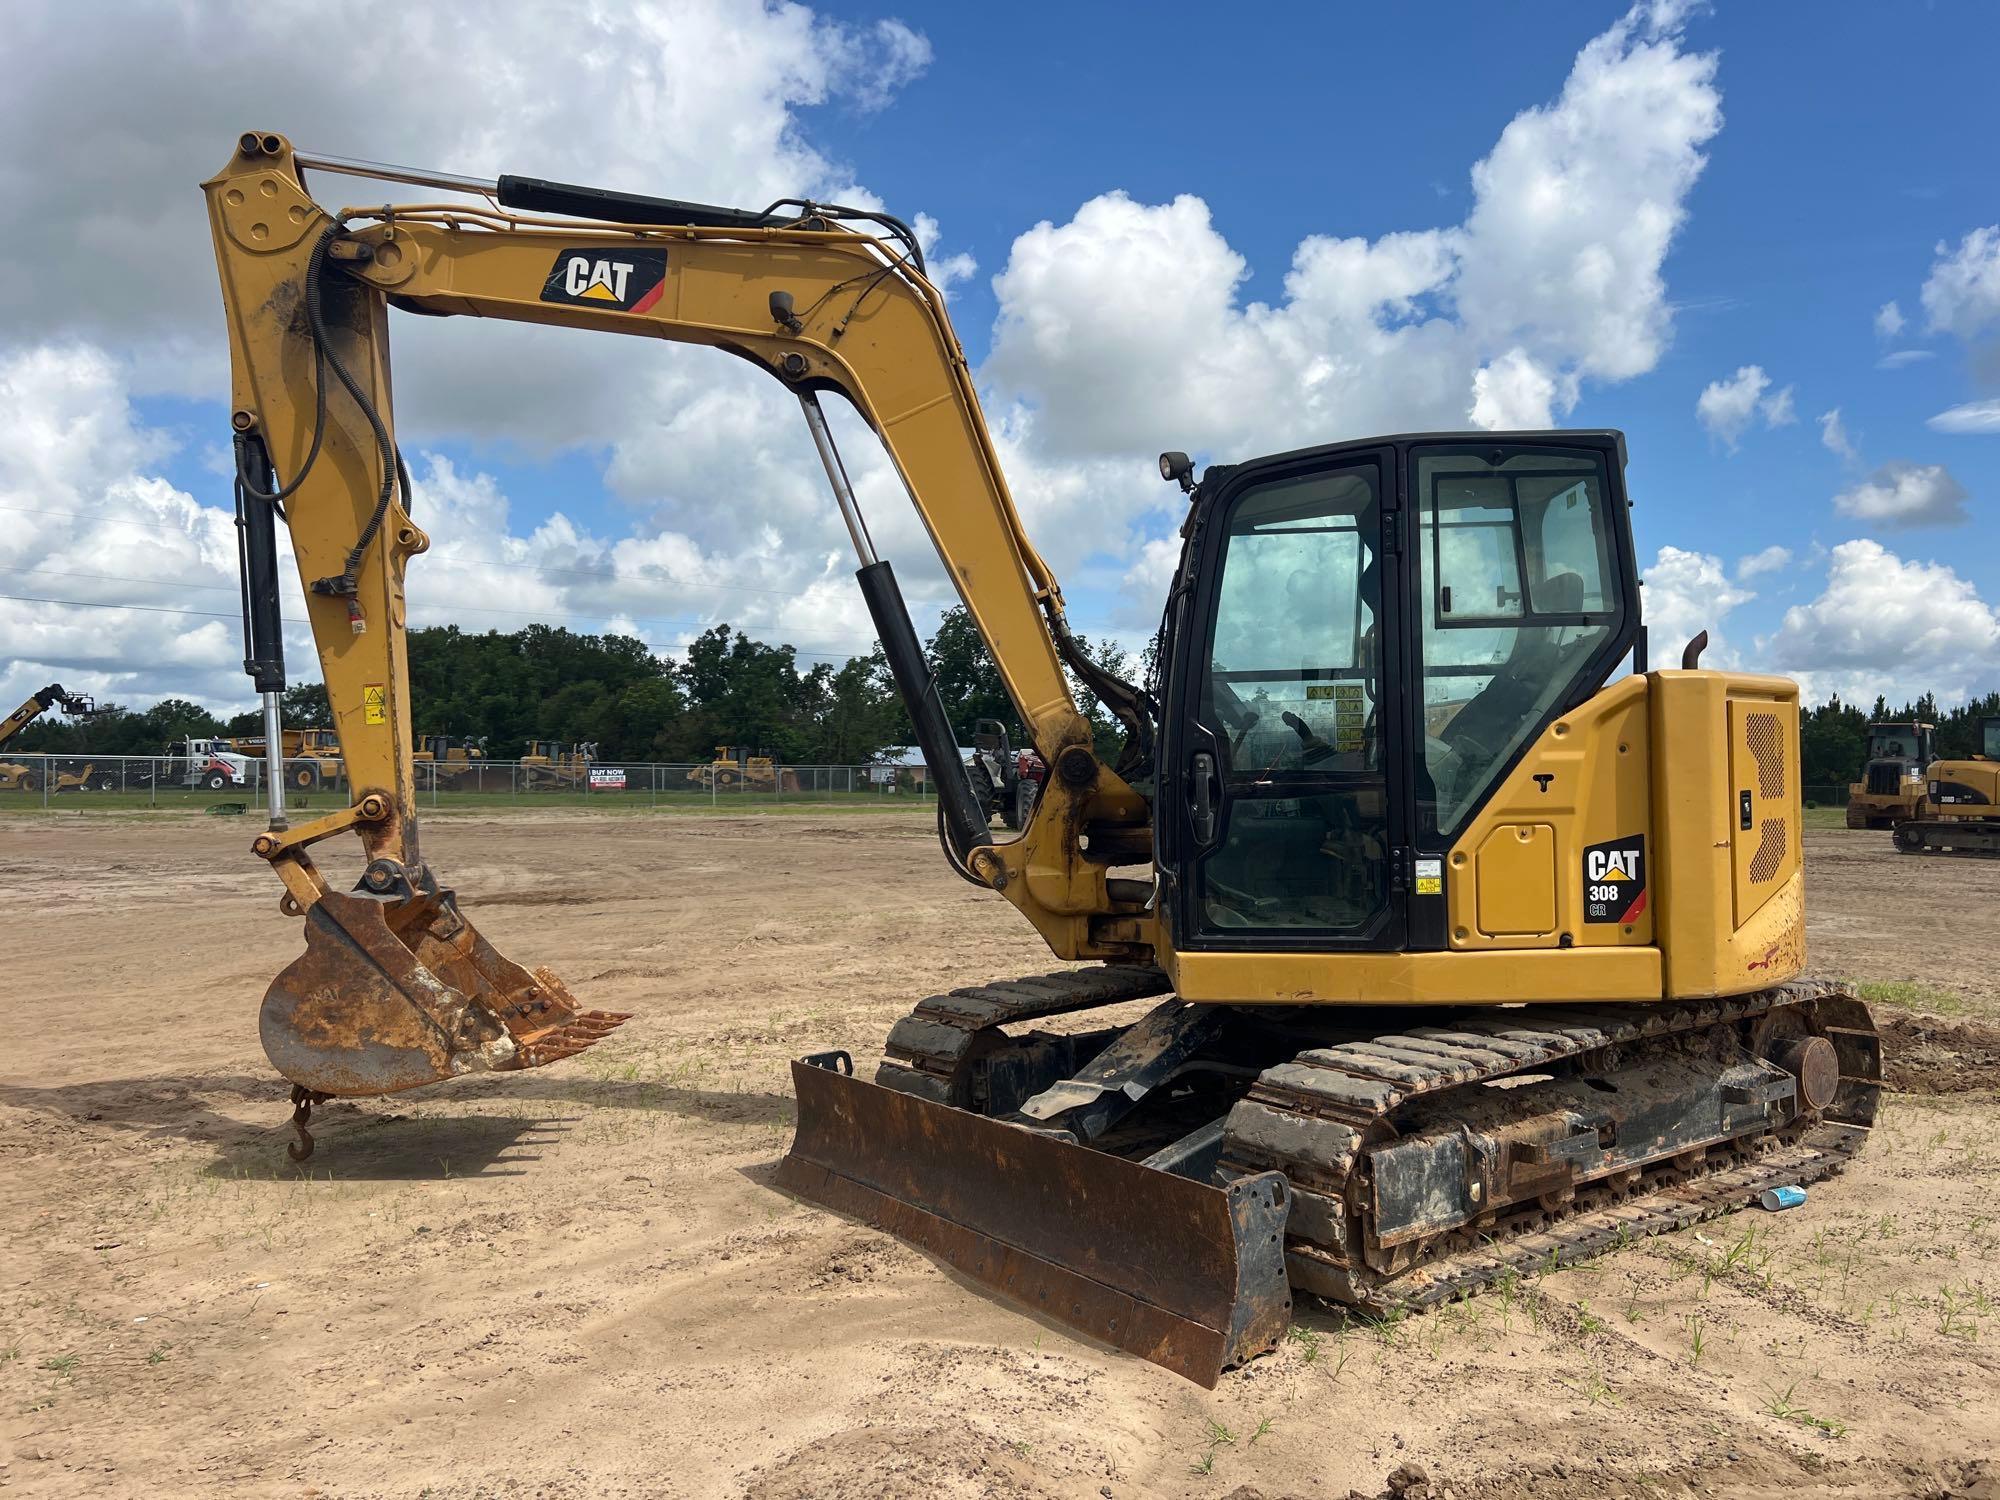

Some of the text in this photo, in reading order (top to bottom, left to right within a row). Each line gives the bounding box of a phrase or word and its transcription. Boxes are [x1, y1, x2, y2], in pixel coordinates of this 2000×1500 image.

[565, 257, 634, 302] CAT
[1588, 850, 1640, 881] CAT
[1589, 885, 1618, 901] 308
[1589, 903, 1606, 916] CR
